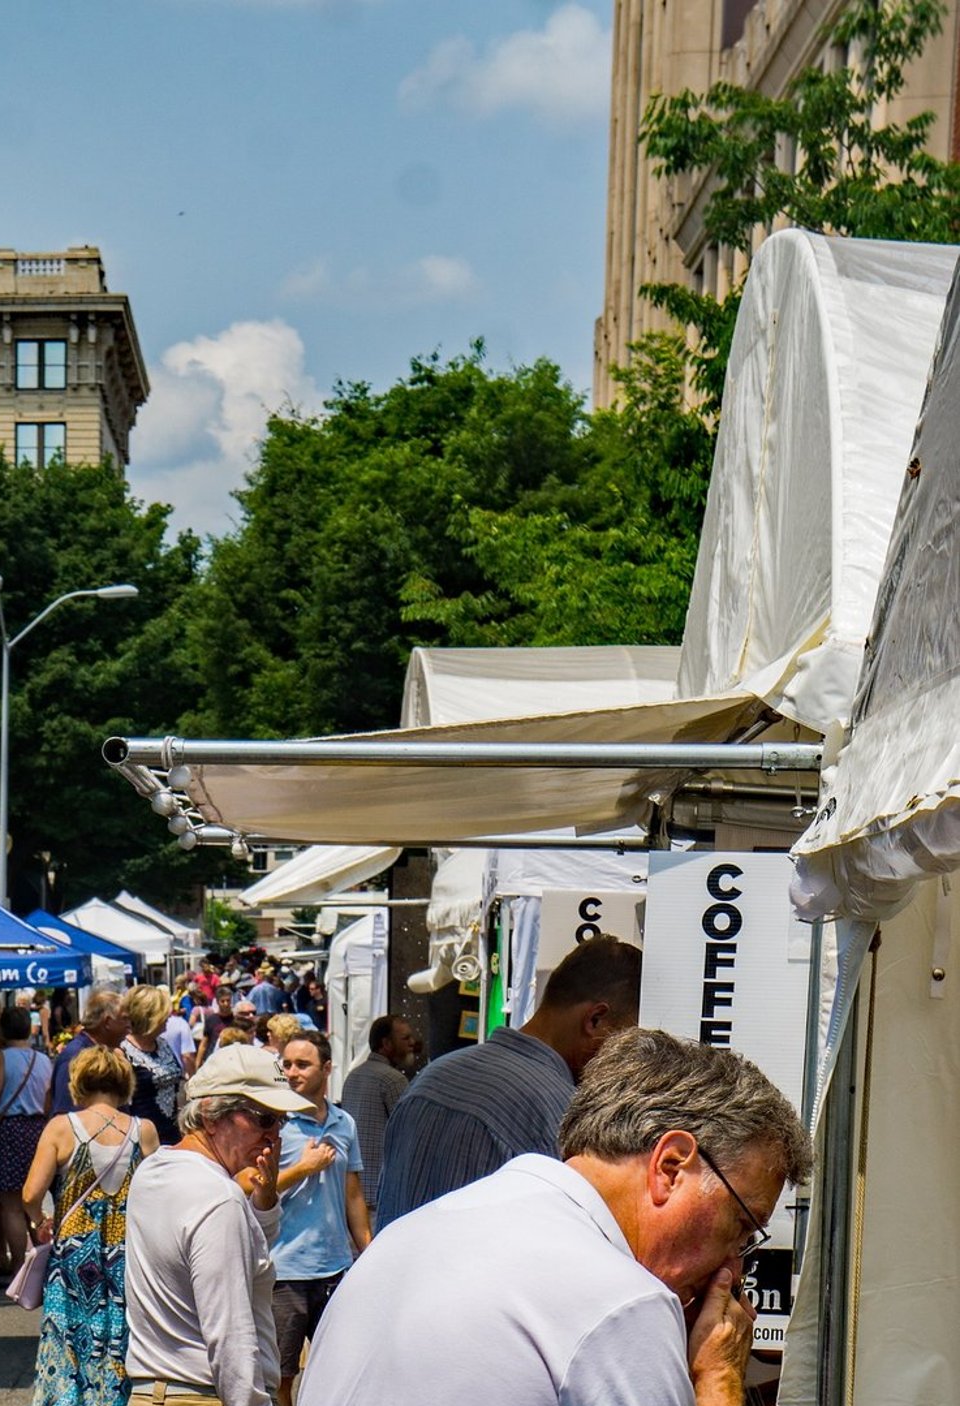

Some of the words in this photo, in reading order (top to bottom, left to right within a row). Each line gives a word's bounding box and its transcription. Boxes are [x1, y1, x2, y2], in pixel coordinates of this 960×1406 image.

[699, 863, 744, 1051] COFFE
[26, 962, 49, 984] Co
[743, 1260, 759, 1289] g
[744, 1288, 782, 1310] on
[753, 1327, 784, 1341] com
